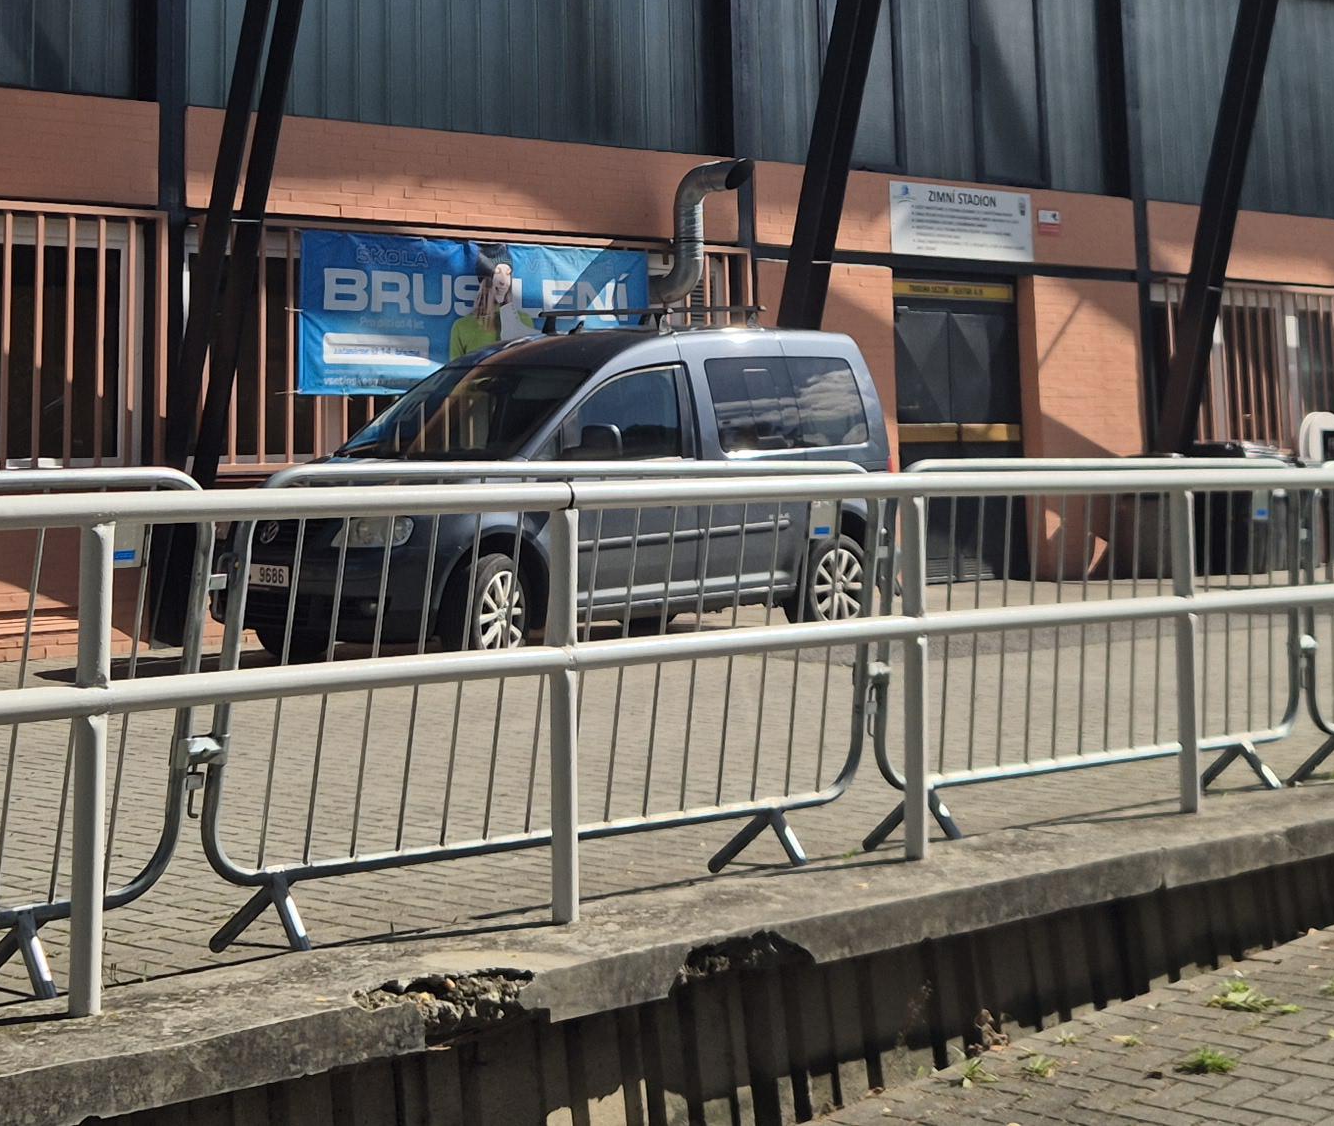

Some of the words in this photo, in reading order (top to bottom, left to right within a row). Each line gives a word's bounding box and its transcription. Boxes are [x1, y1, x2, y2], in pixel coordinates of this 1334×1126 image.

[927, 189, 955, 204] ZIMNÍ
[355, 242, 429, 268] ŠKOLA
[259, 566, 285, 584] 9686
